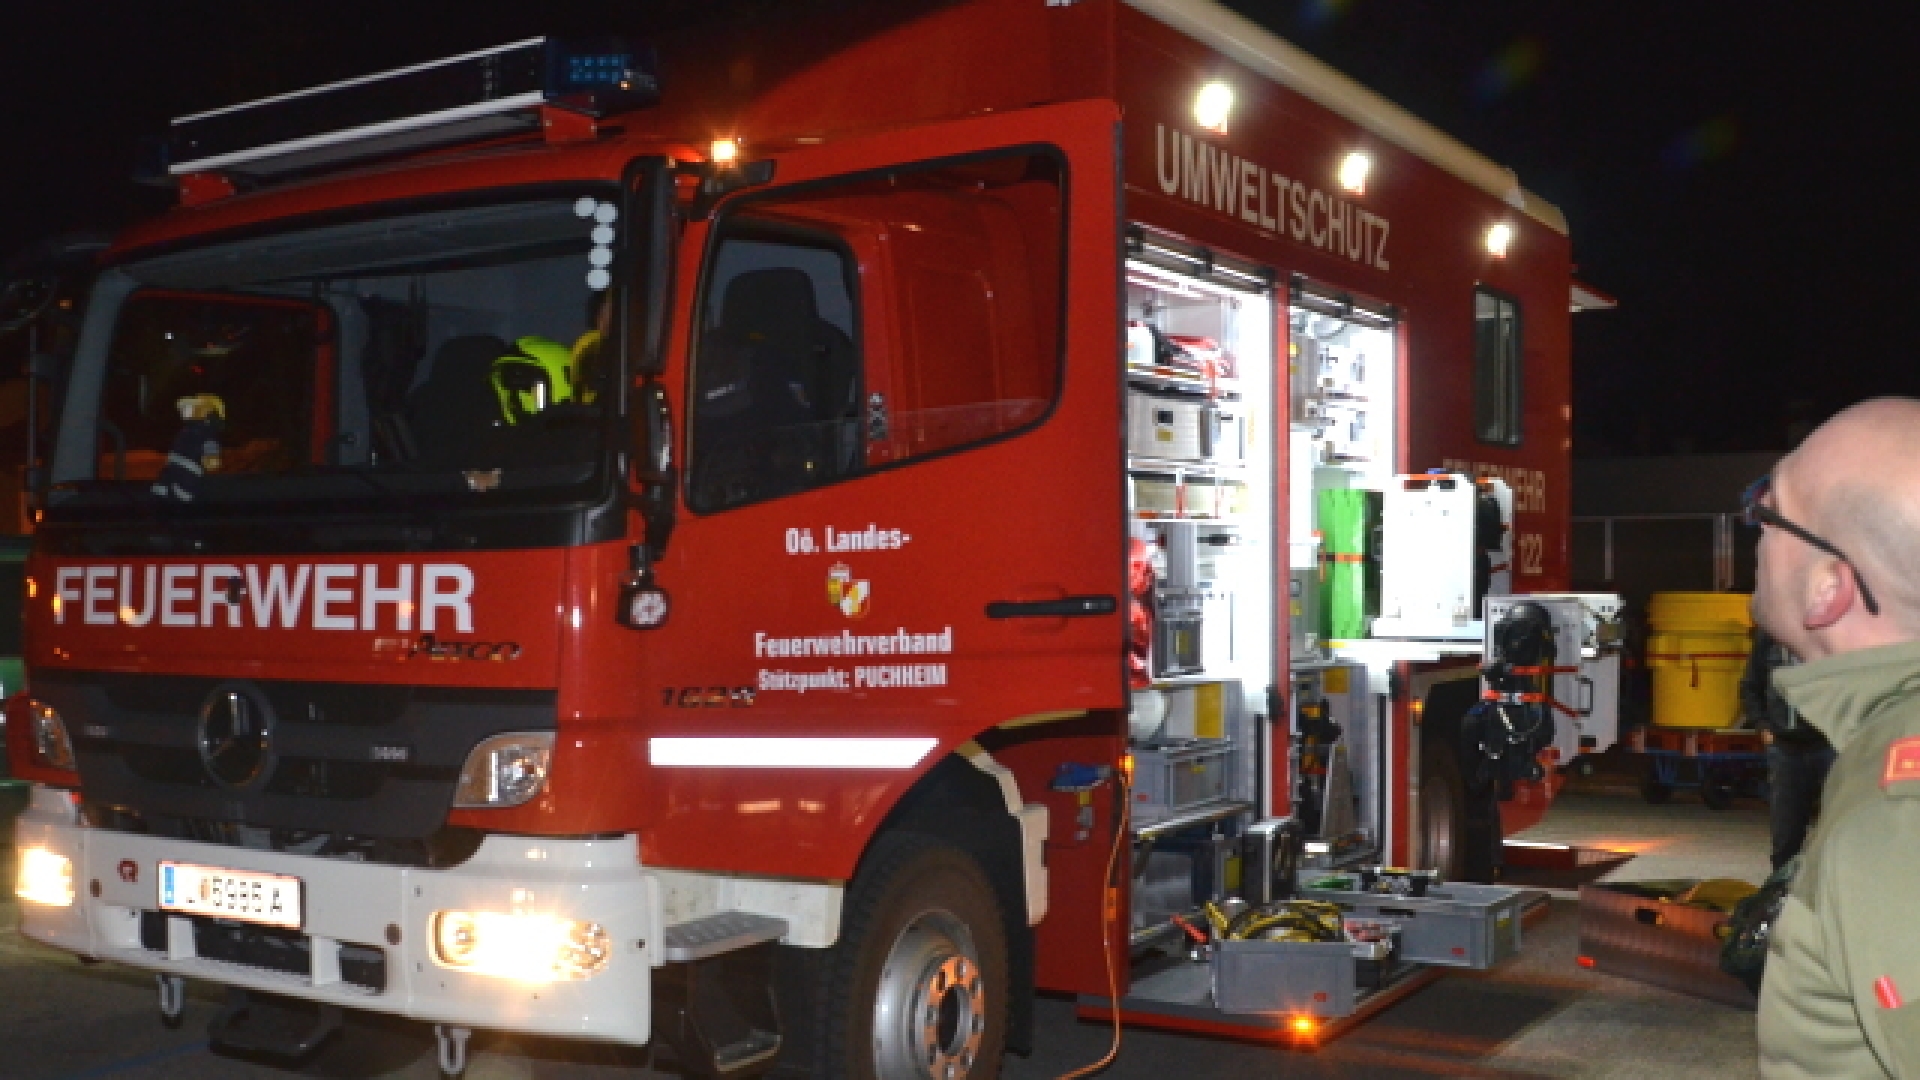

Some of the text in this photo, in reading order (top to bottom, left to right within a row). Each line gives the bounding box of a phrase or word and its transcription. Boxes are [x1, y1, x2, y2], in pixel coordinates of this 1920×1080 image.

[1157, 123, 1390, 270] UMWELTSCHUTZ
[825, 523, 911, 552] Landes-
[54, 564, 475, 632] FEUERWEHR
[754, 625, 952, 657] Feuerwehrverband
[854, 663, 947, 687] PUCHHEIM
